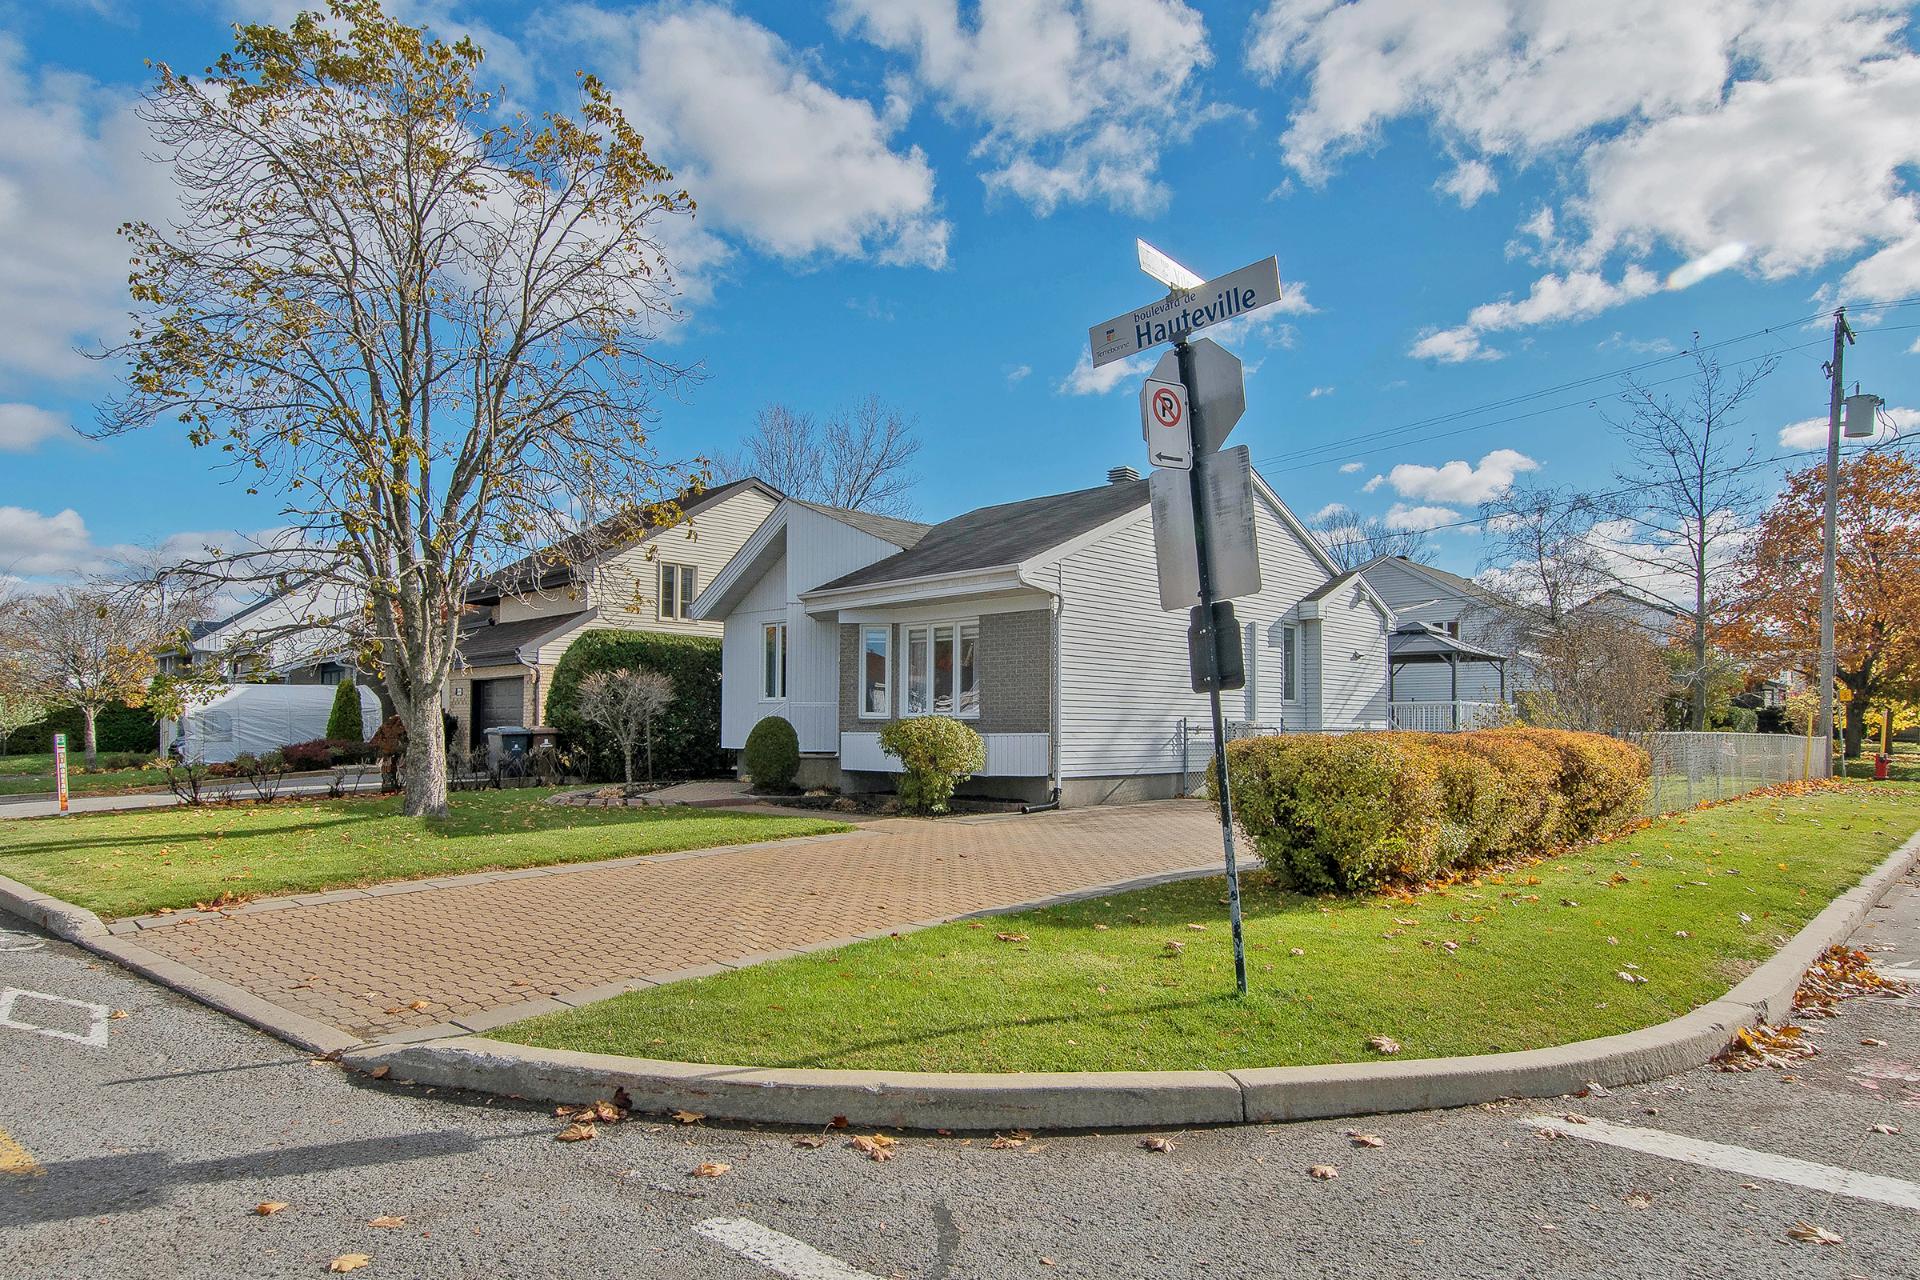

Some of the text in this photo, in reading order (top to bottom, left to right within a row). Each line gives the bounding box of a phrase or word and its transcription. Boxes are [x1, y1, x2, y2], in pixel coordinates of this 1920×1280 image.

[1134, 292, 1196, 323] boulevard de
[1136, 287, 1256, 349] Hauteville
